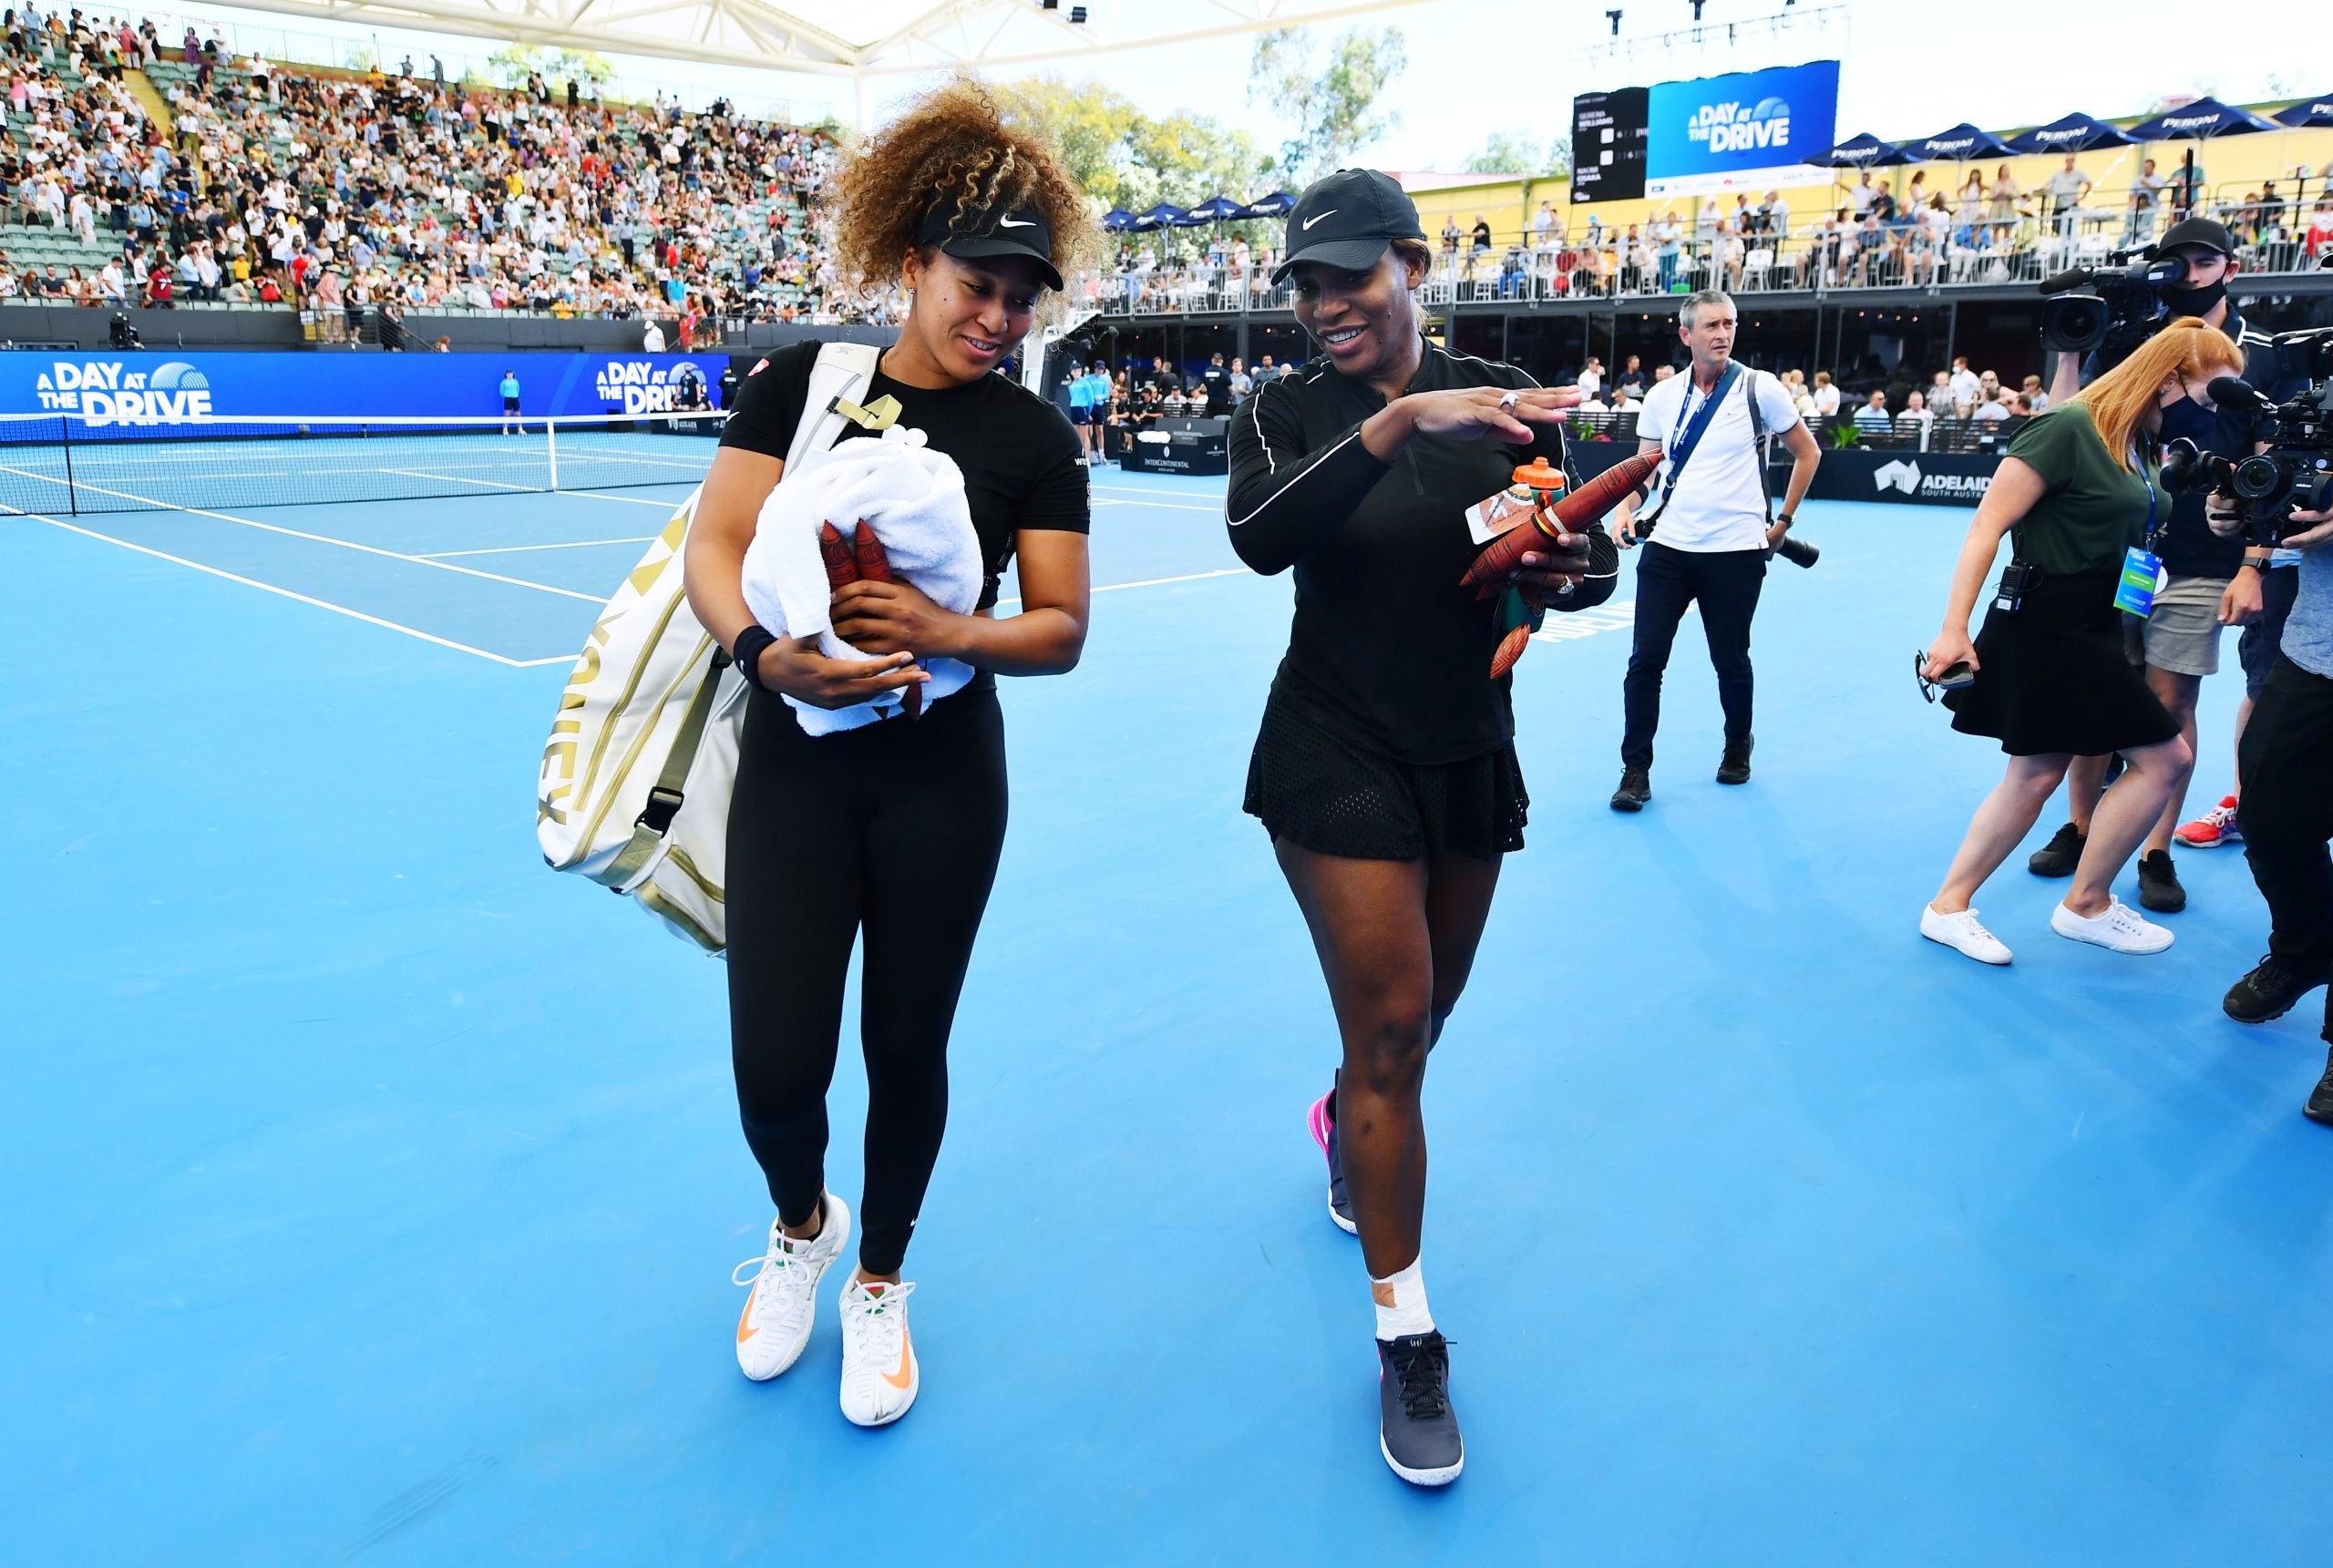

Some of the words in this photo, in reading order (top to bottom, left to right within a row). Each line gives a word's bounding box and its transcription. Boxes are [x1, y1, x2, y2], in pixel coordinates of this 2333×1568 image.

[1689, 115, 1699, 128] A
[1700, 101, 1740, 127] DAY
[1736, 108, 1753, 123] AT
[2162, 113, 2221, 129] PERONI
[1688, 127, 1710, 142] THE
[1710, 117, 1790, 153] DRIVE
[1925, 138, 1975, 151] PERONI
[2035, 126, 2089, 141] PERONI
[1831, 146, 1879, 159] PERONI
[36, 373, 55, 390] A
[53, 362, 123, 391] DAY
[123, 373, 148, 390] AT
[596, 371, 608, 385] A
[607, 362, 653, 385] DAY
[651, 370, 667, 384] AT
[37, 392, 79, 409] THE
[81, 390, 212, 426] DRIVE
[597, 385, 623, 400] THE
[623, 384, 707, 415] DRI
[1922, 475, 1992, 491] ADELAID
